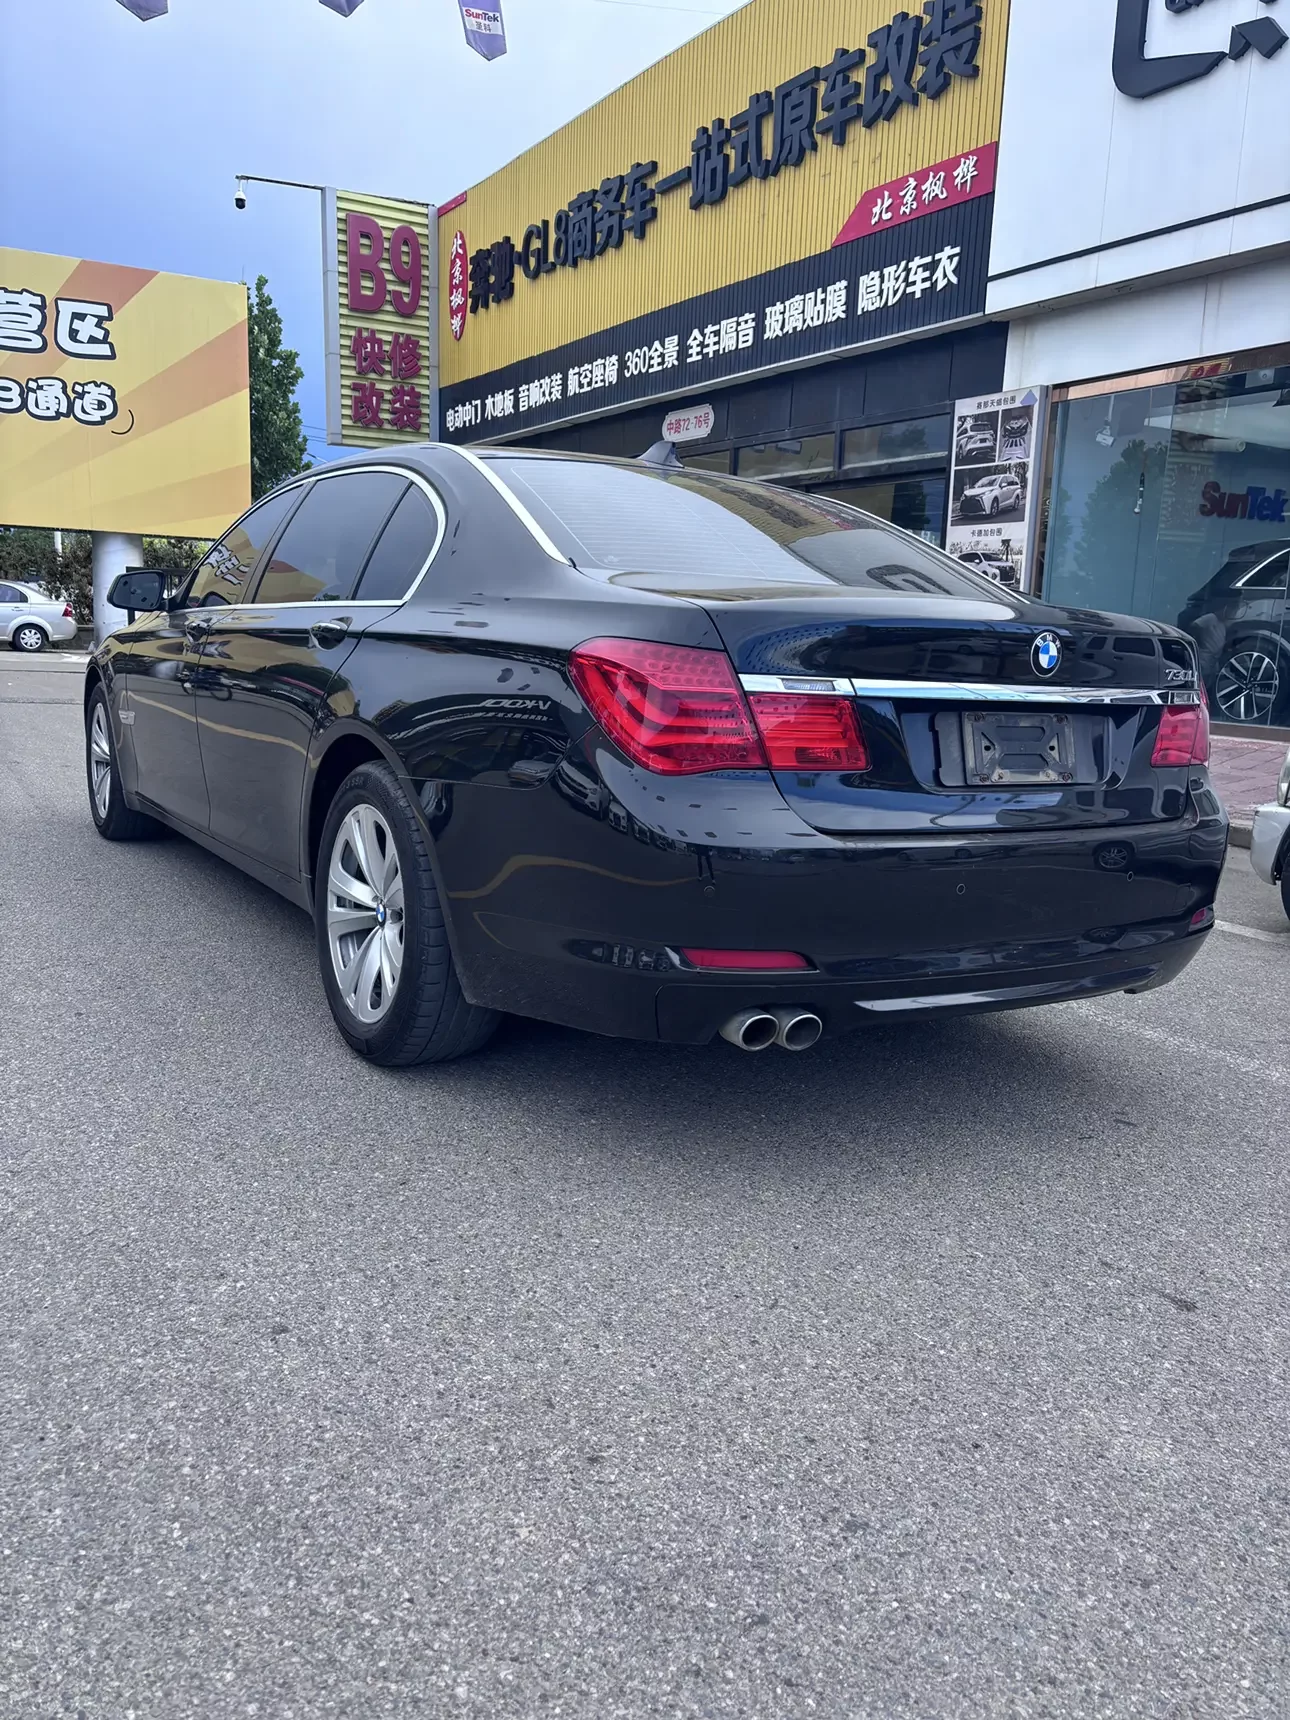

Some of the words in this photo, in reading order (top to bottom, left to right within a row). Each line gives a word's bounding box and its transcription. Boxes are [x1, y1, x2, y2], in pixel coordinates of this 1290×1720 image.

[465, 9, 499, 22] SunTek
[871, 155, 979, 226] 北京枫桦
[346, 213, 422, 317] B9
[351, 327, 422, 380] 快修
[446, 398, 482, 432] 电动中门
[484, 388, 514, 421] 木地板
[518, 373, 563, 412] 音响改装
[567, 354, 619, 397] 航空座椅
[624, 335, 679, 378] 360全景
[686, 313, 756, 364] 全车隔音
[764, 280, 848, 341] 玻璃贴膜
[857, 246, 961, 316] 隐形车衣
[351, 381, 422, 431] 改装
[1199, 481, 1289, 522] SunTek
